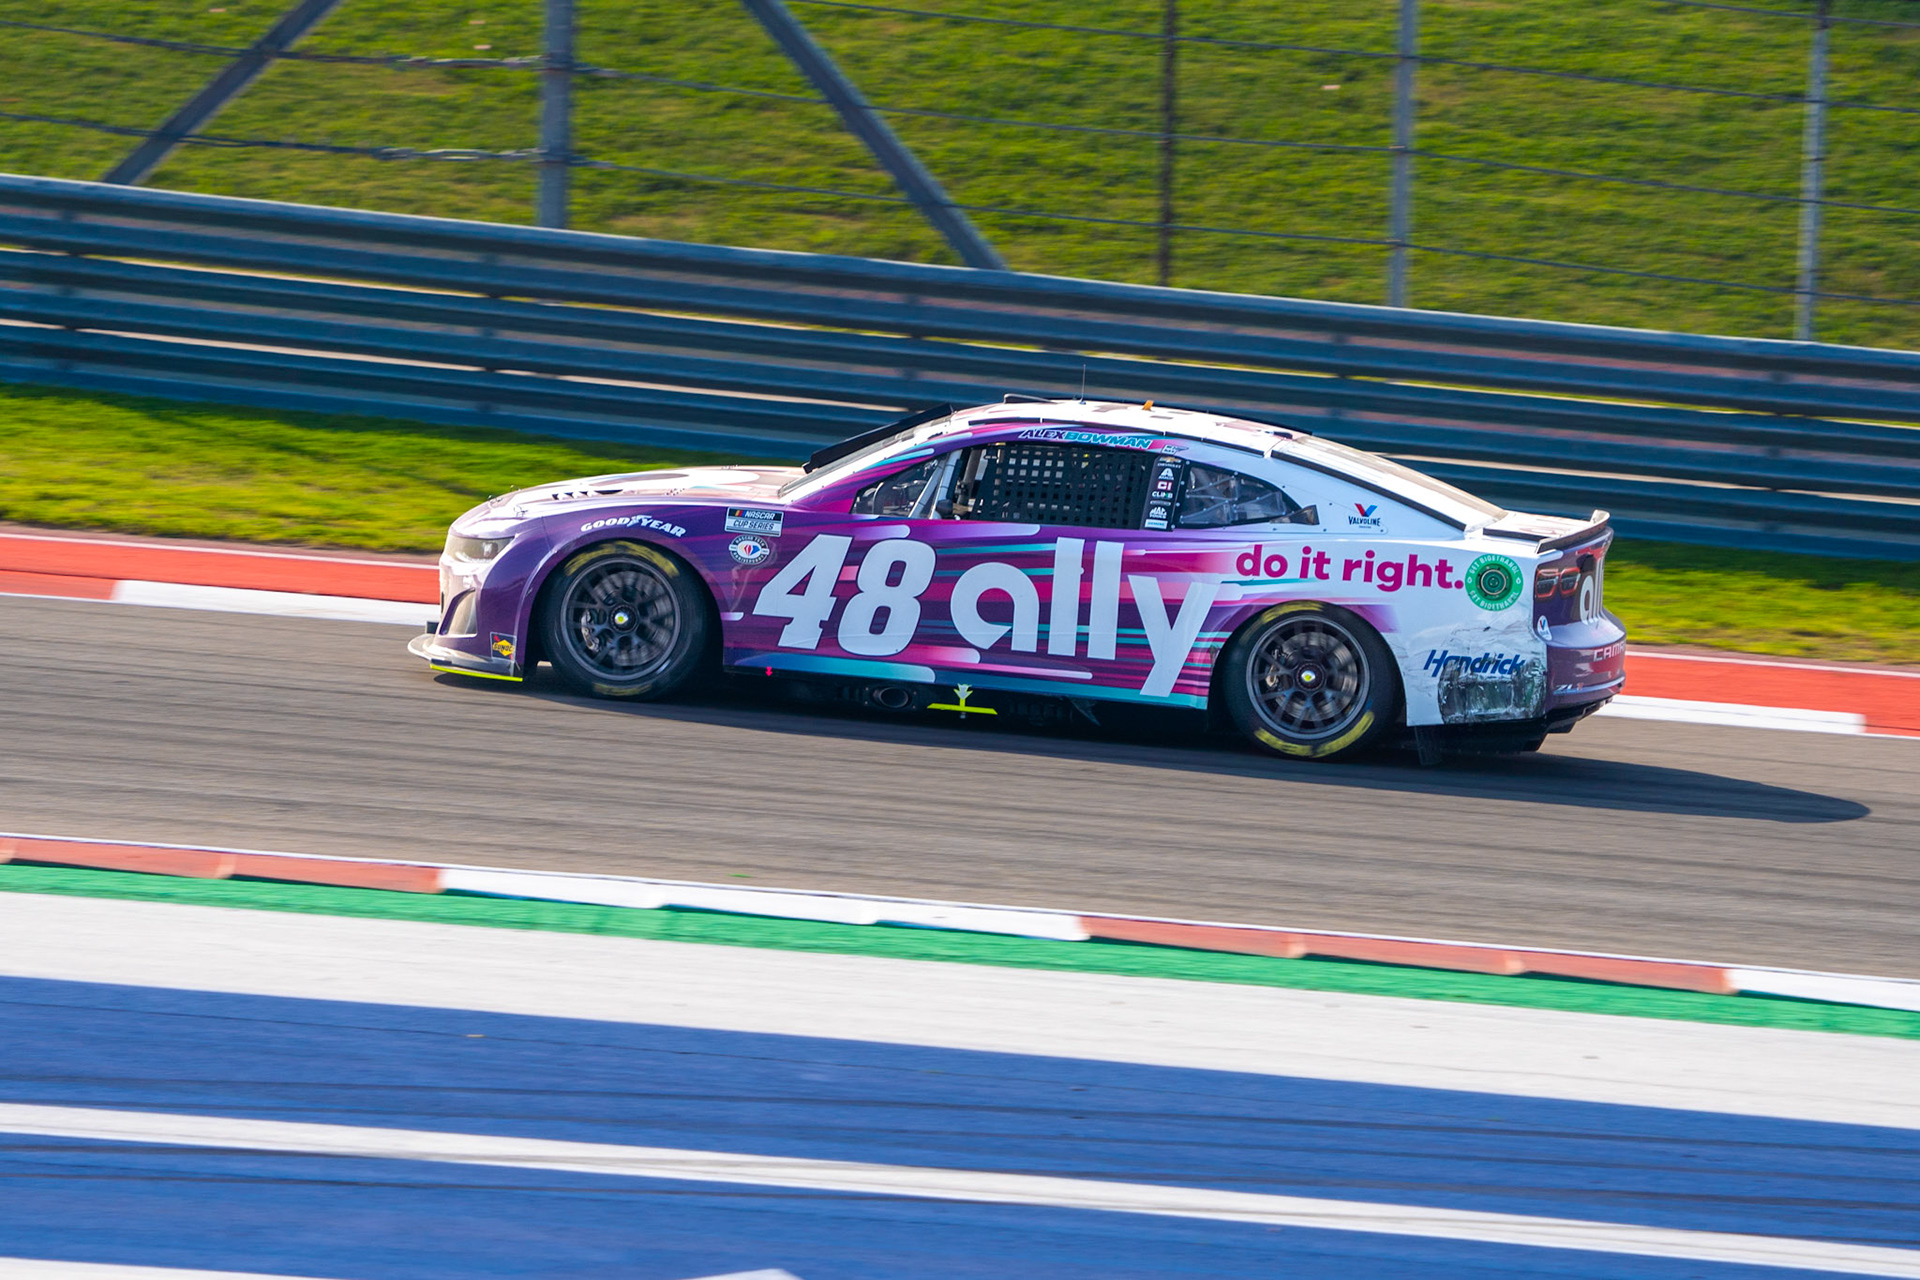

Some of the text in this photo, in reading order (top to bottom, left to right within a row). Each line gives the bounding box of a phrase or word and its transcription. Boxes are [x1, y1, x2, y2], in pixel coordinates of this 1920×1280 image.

[733, 519, 775, 531] CUP SERIES
[744, 510, 776, 520] NASCAR
[1348, 515, 1382, 527] VALVOLINE
[580, 514, 687, 538] GOODYEAR
[1235, 544, 1464, 592] do it right.
[1469, 554, 1520, 575] GET BIOETHANOL
[1470, 590, 1480, 603] GET
[752, 533, 1221, 697] 48 ally
[1423, 649, 1526, 677] Hendrick
